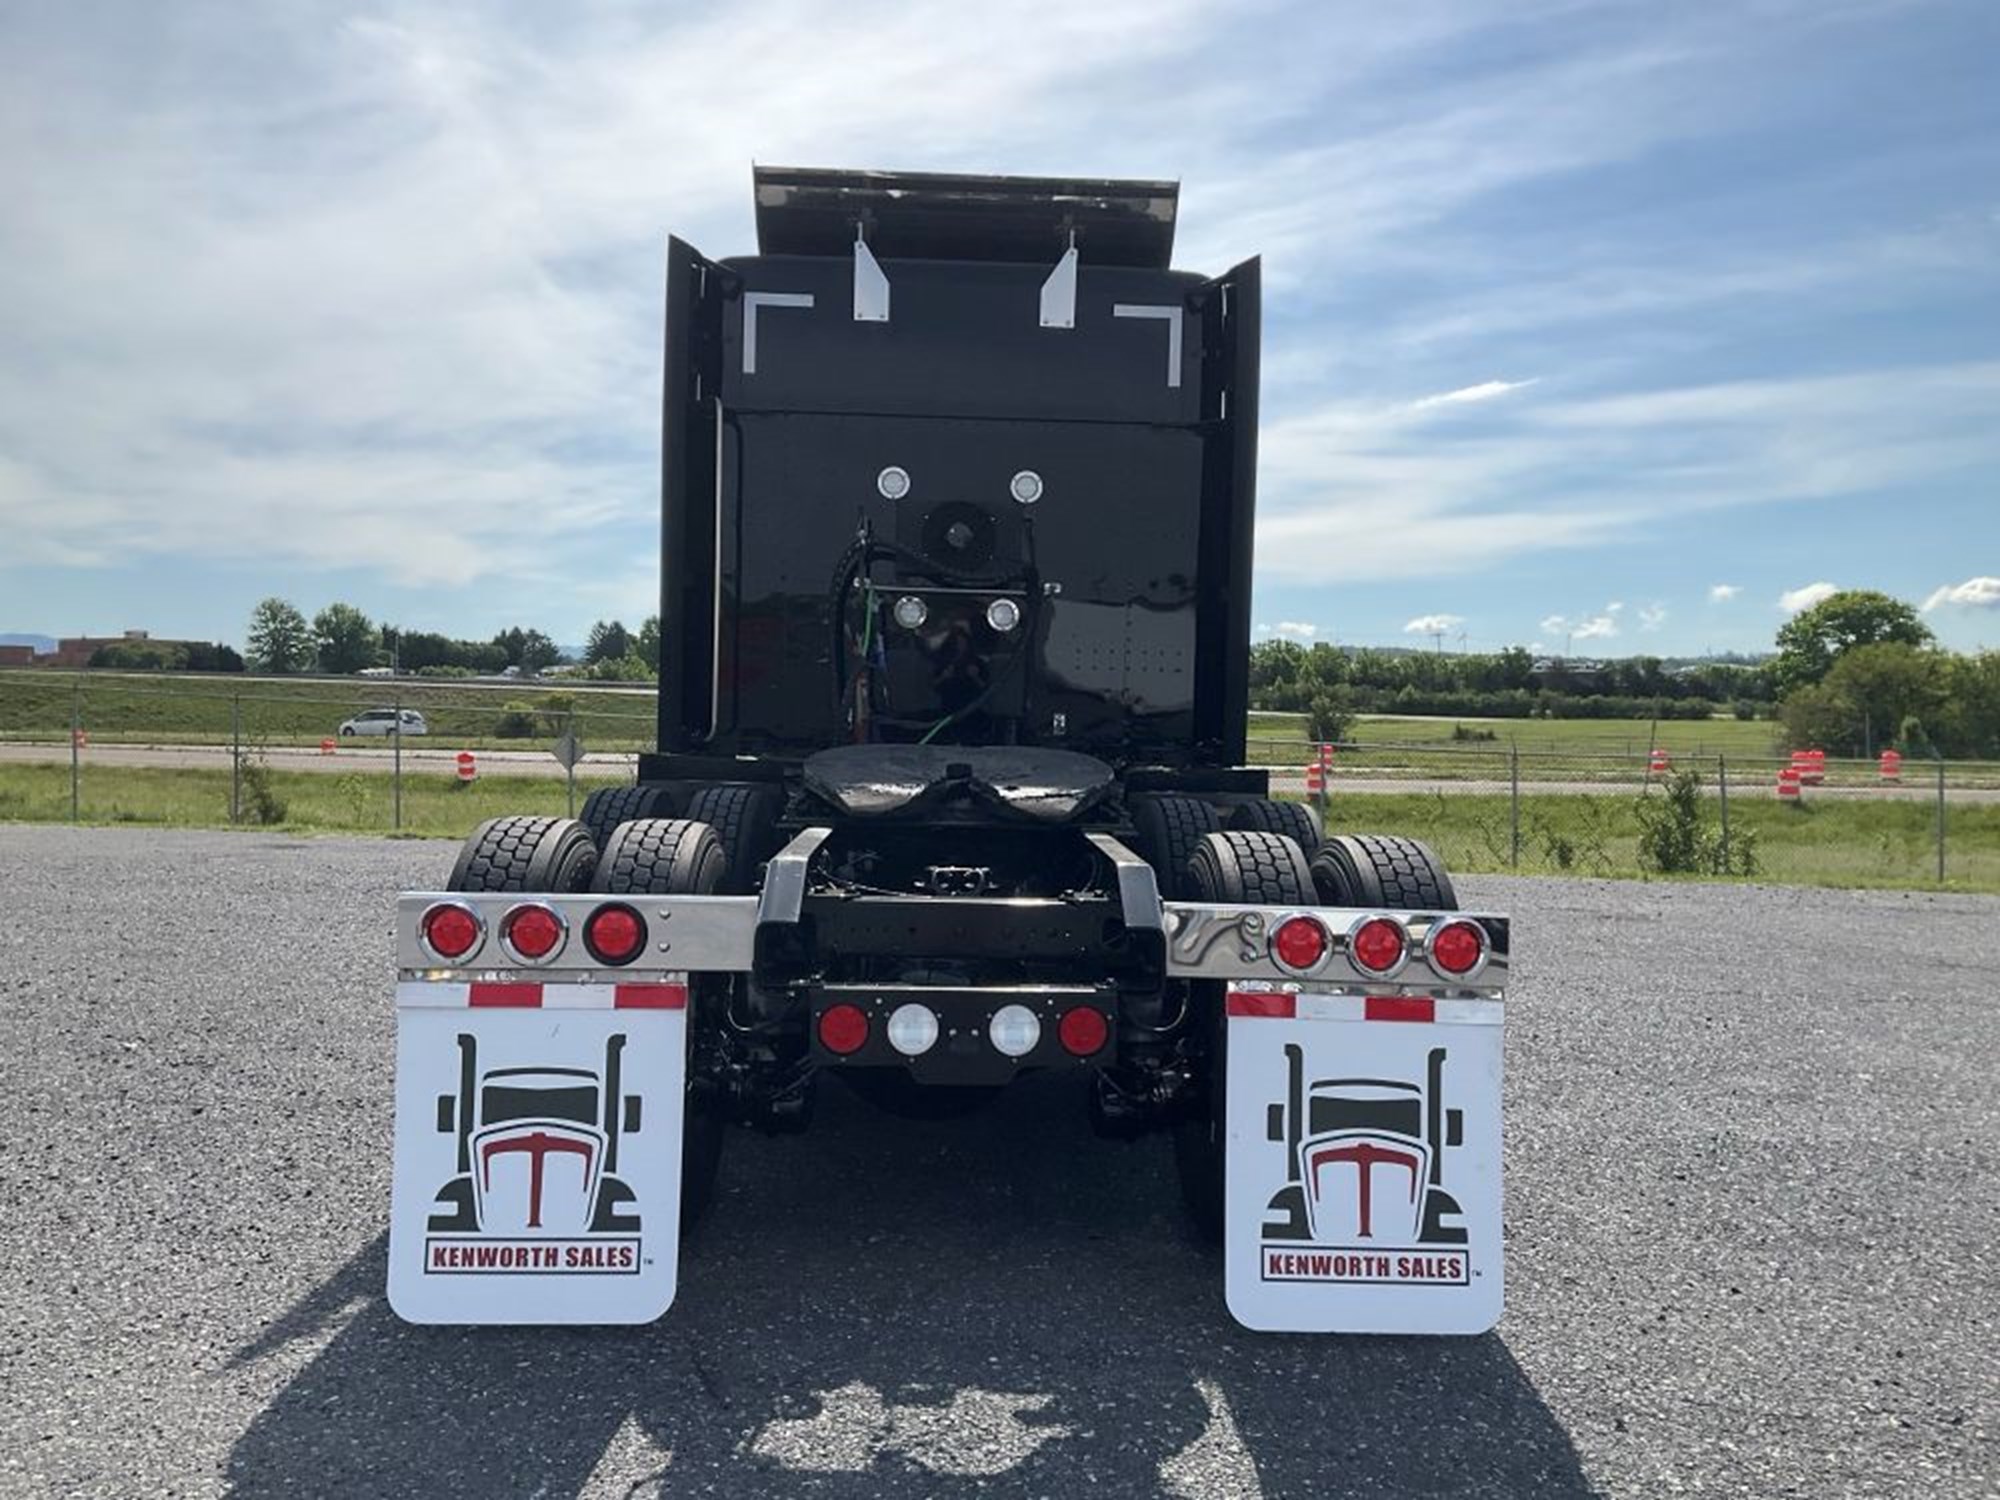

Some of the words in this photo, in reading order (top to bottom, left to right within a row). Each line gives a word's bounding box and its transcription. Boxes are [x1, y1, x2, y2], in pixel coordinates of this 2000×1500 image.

[433, 1246, 558, 1268] KENWORTH
[565, 1246, 633, 1268] SALES
[1269, 1254, 1390, 1277] KENWORTH
[1397, 1257, 1461, 1279] SALES
